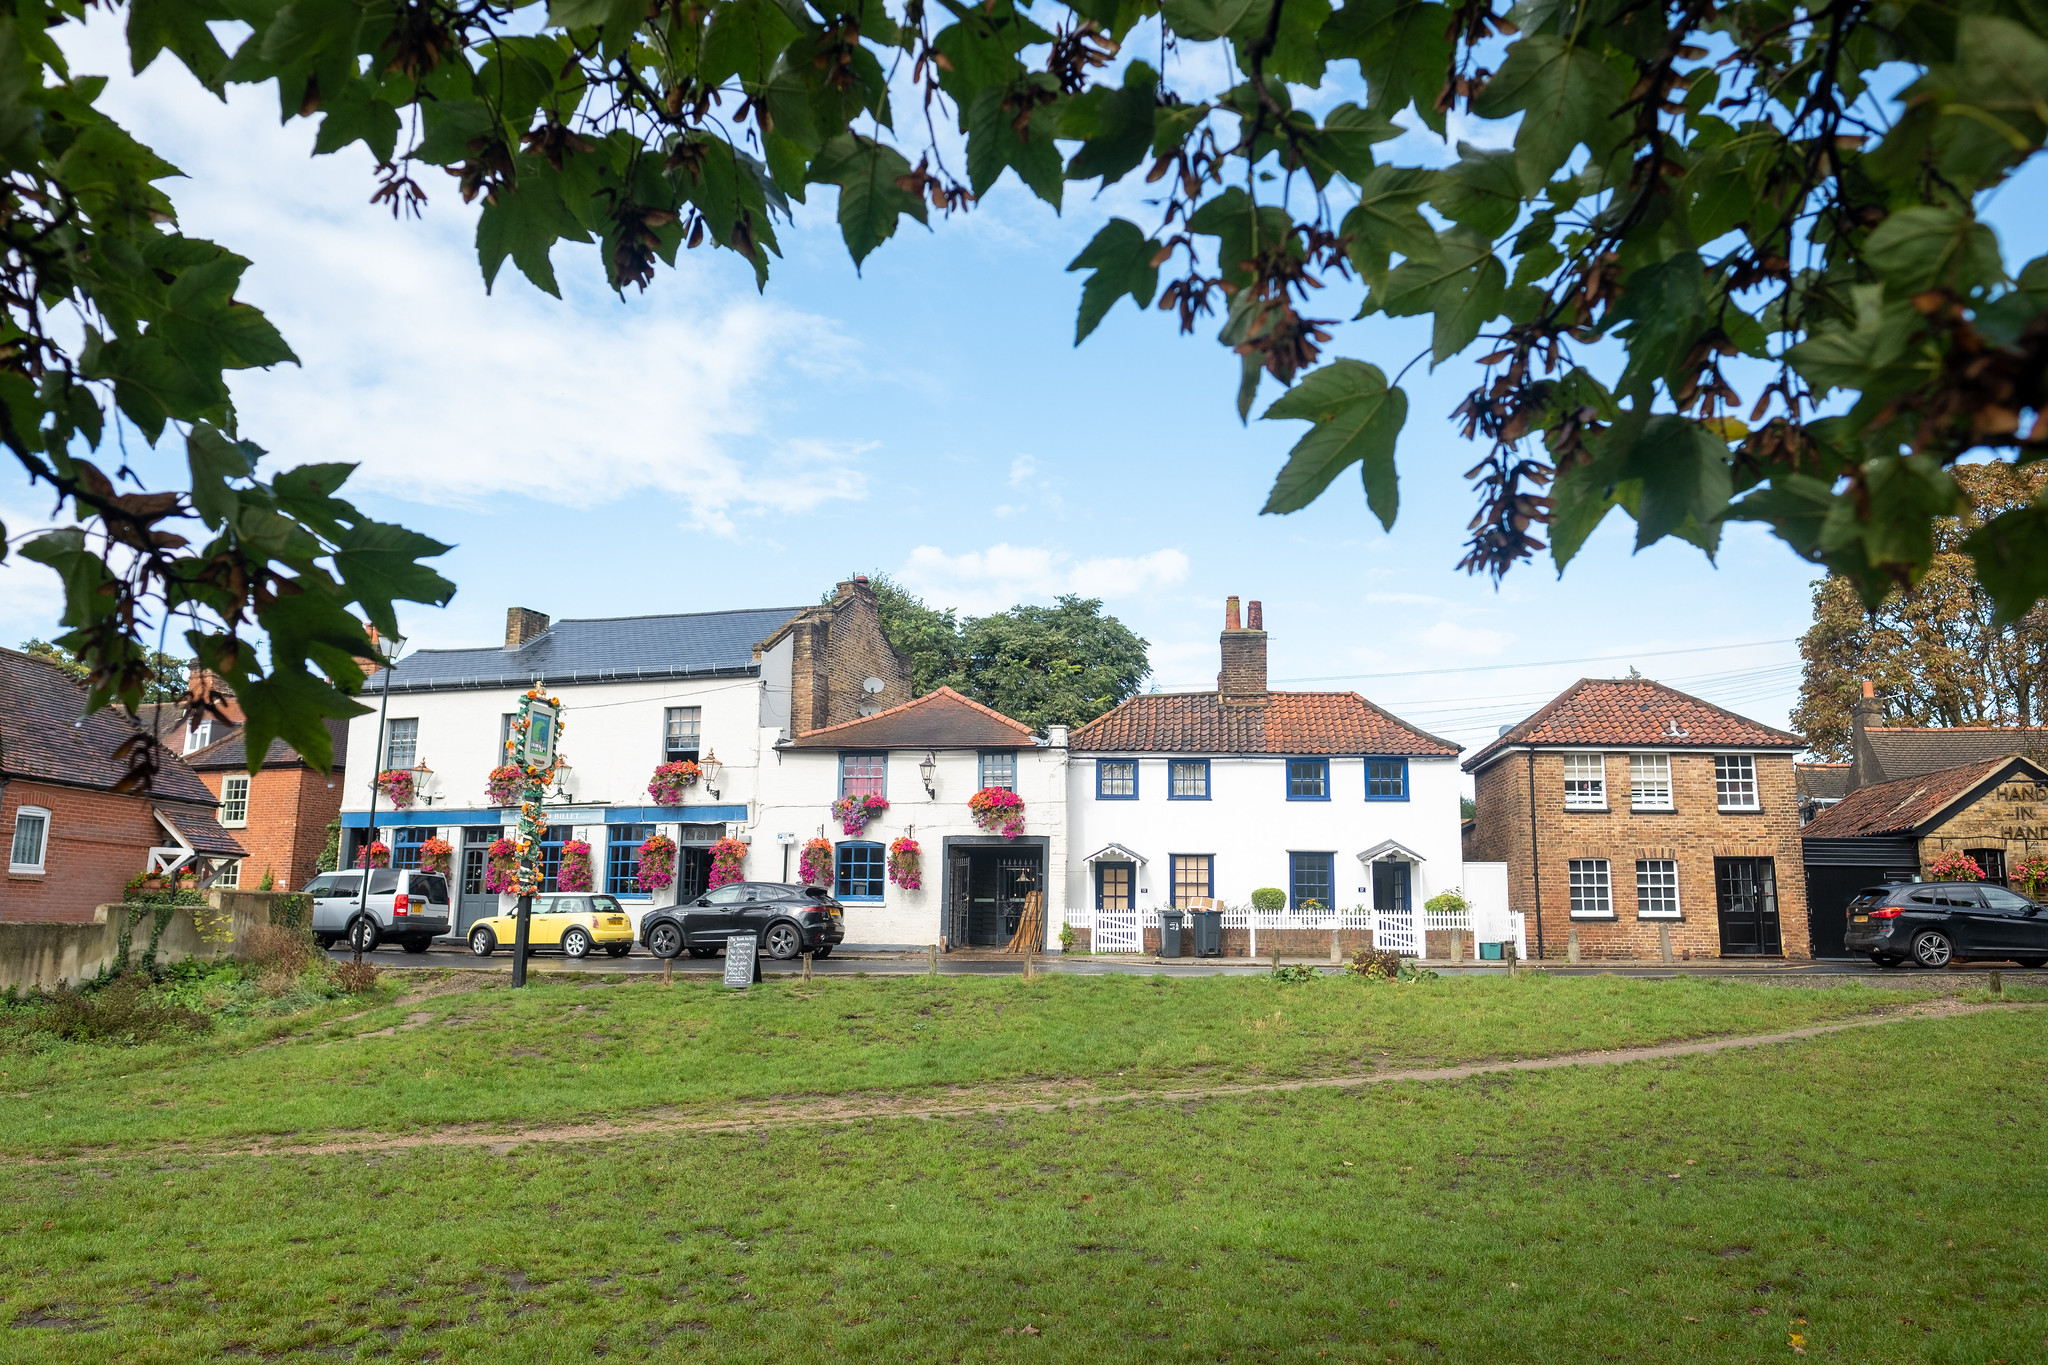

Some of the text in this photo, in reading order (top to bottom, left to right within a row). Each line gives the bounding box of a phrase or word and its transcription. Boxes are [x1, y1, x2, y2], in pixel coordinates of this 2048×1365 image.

[1997, 787, 2048, 801] HAND
[2016, 807, 2033, 820] IN
[2002, 826, 2048, 839] HAND
